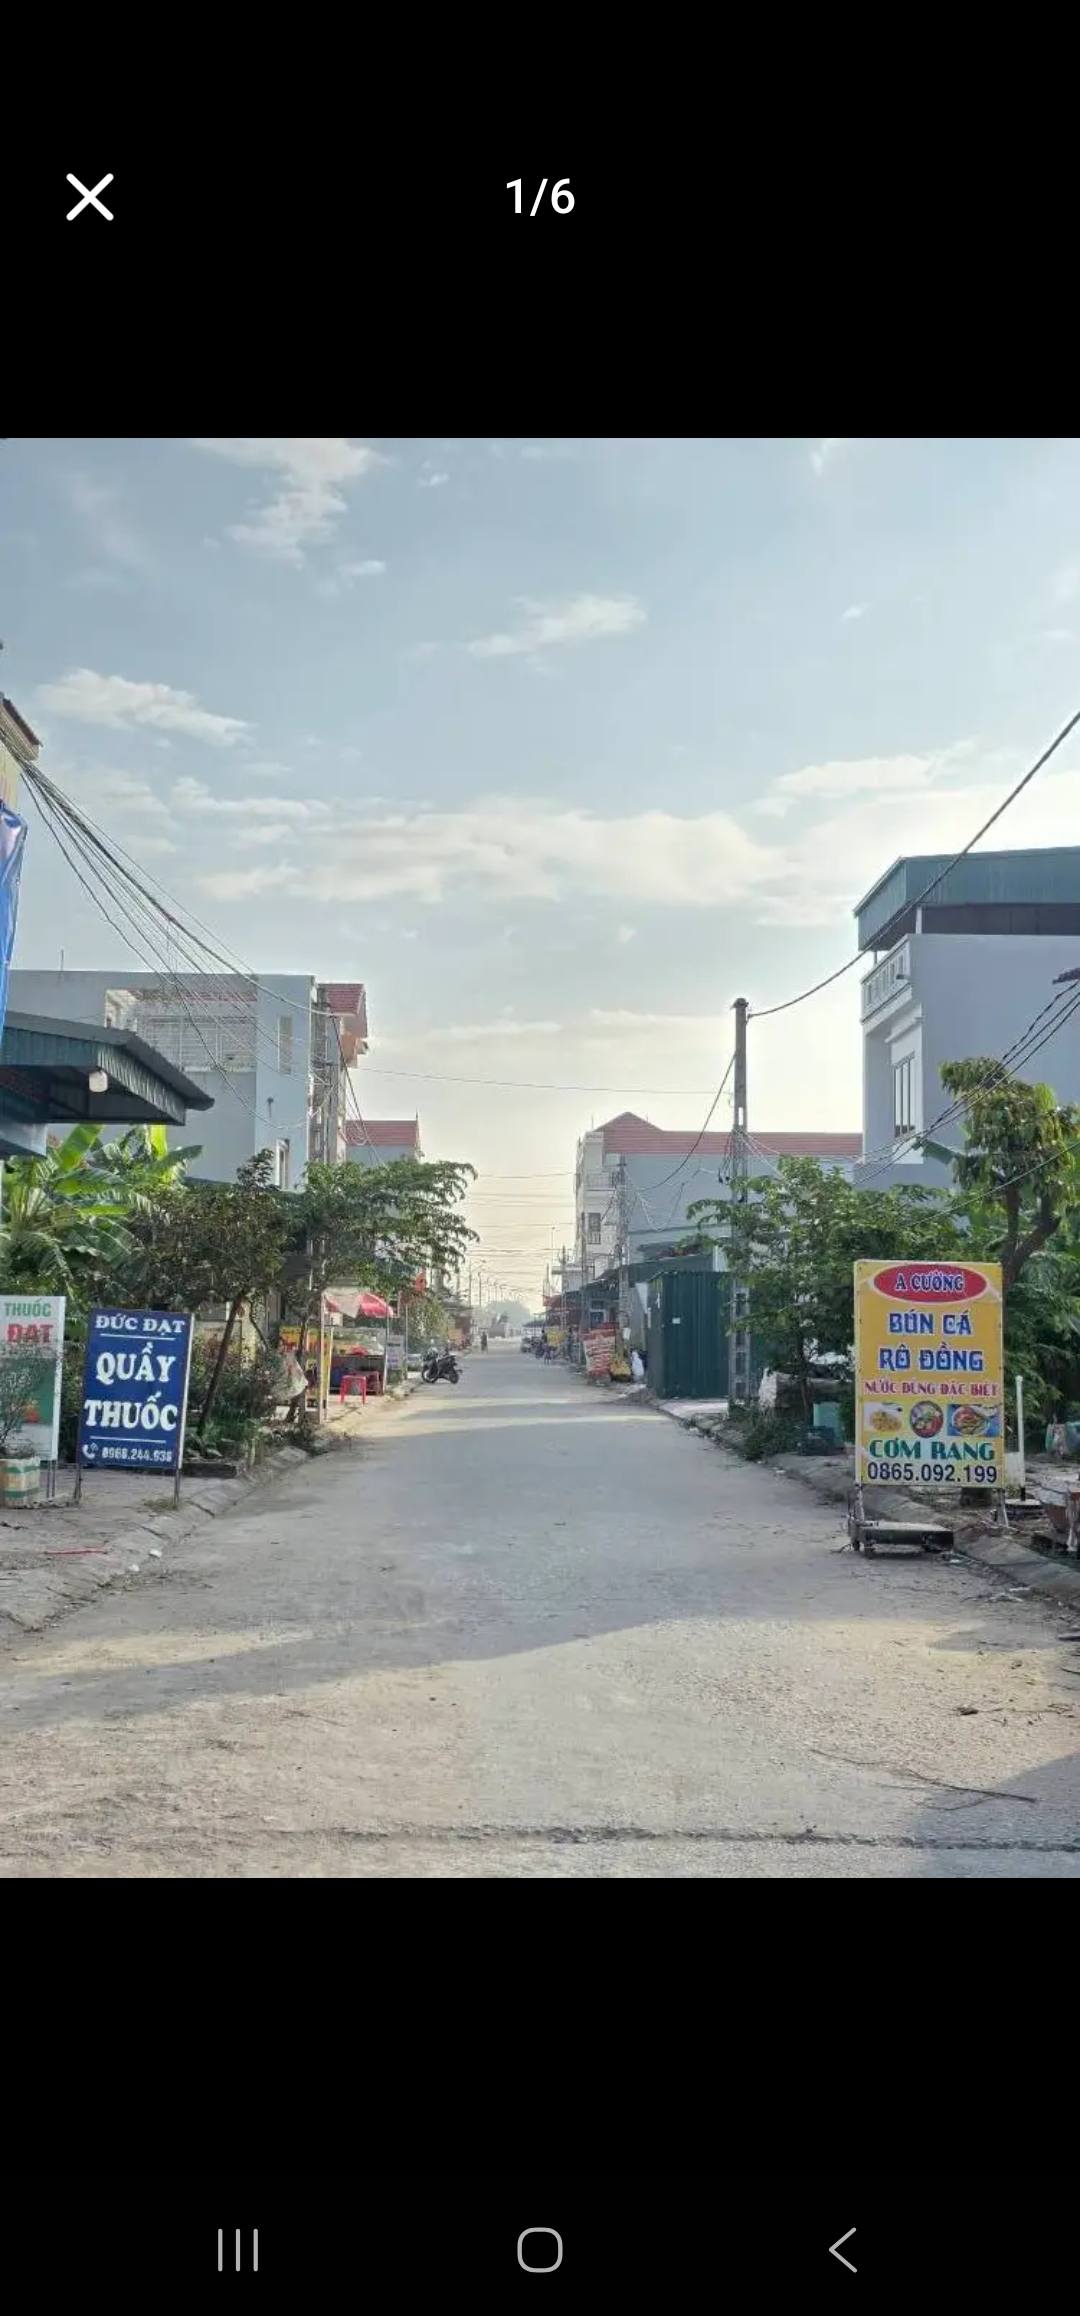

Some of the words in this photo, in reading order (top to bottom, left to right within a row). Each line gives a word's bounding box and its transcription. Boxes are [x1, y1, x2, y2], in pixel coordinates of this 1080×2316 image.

[895, 1272, 908, 1291] A
[910, 1270, 966, 1293] CƯỜNG
[95, 1312, 138, 1330] ĐỨC
[143, 1317, 186, 1336] ĐẠT
[888, 1308, 936, 1335] BÚN
[941, 1309, 973, 1336] CÁ
[95, 1341, 177, 1386] QUẦY
[878, 1343, 911, 1372] RÔ
[918, 1341, 984, 1373] ĐỒNG
[863, 1377, 899, 1395] NƯỚC
[83, 1391, 178, 1431] THUỐC
[868, 1436, 922, 1460] CƠM
[930, 1441, 996, 1462] RANG
[866, 1461, 998, 1484] 0865.092.199
